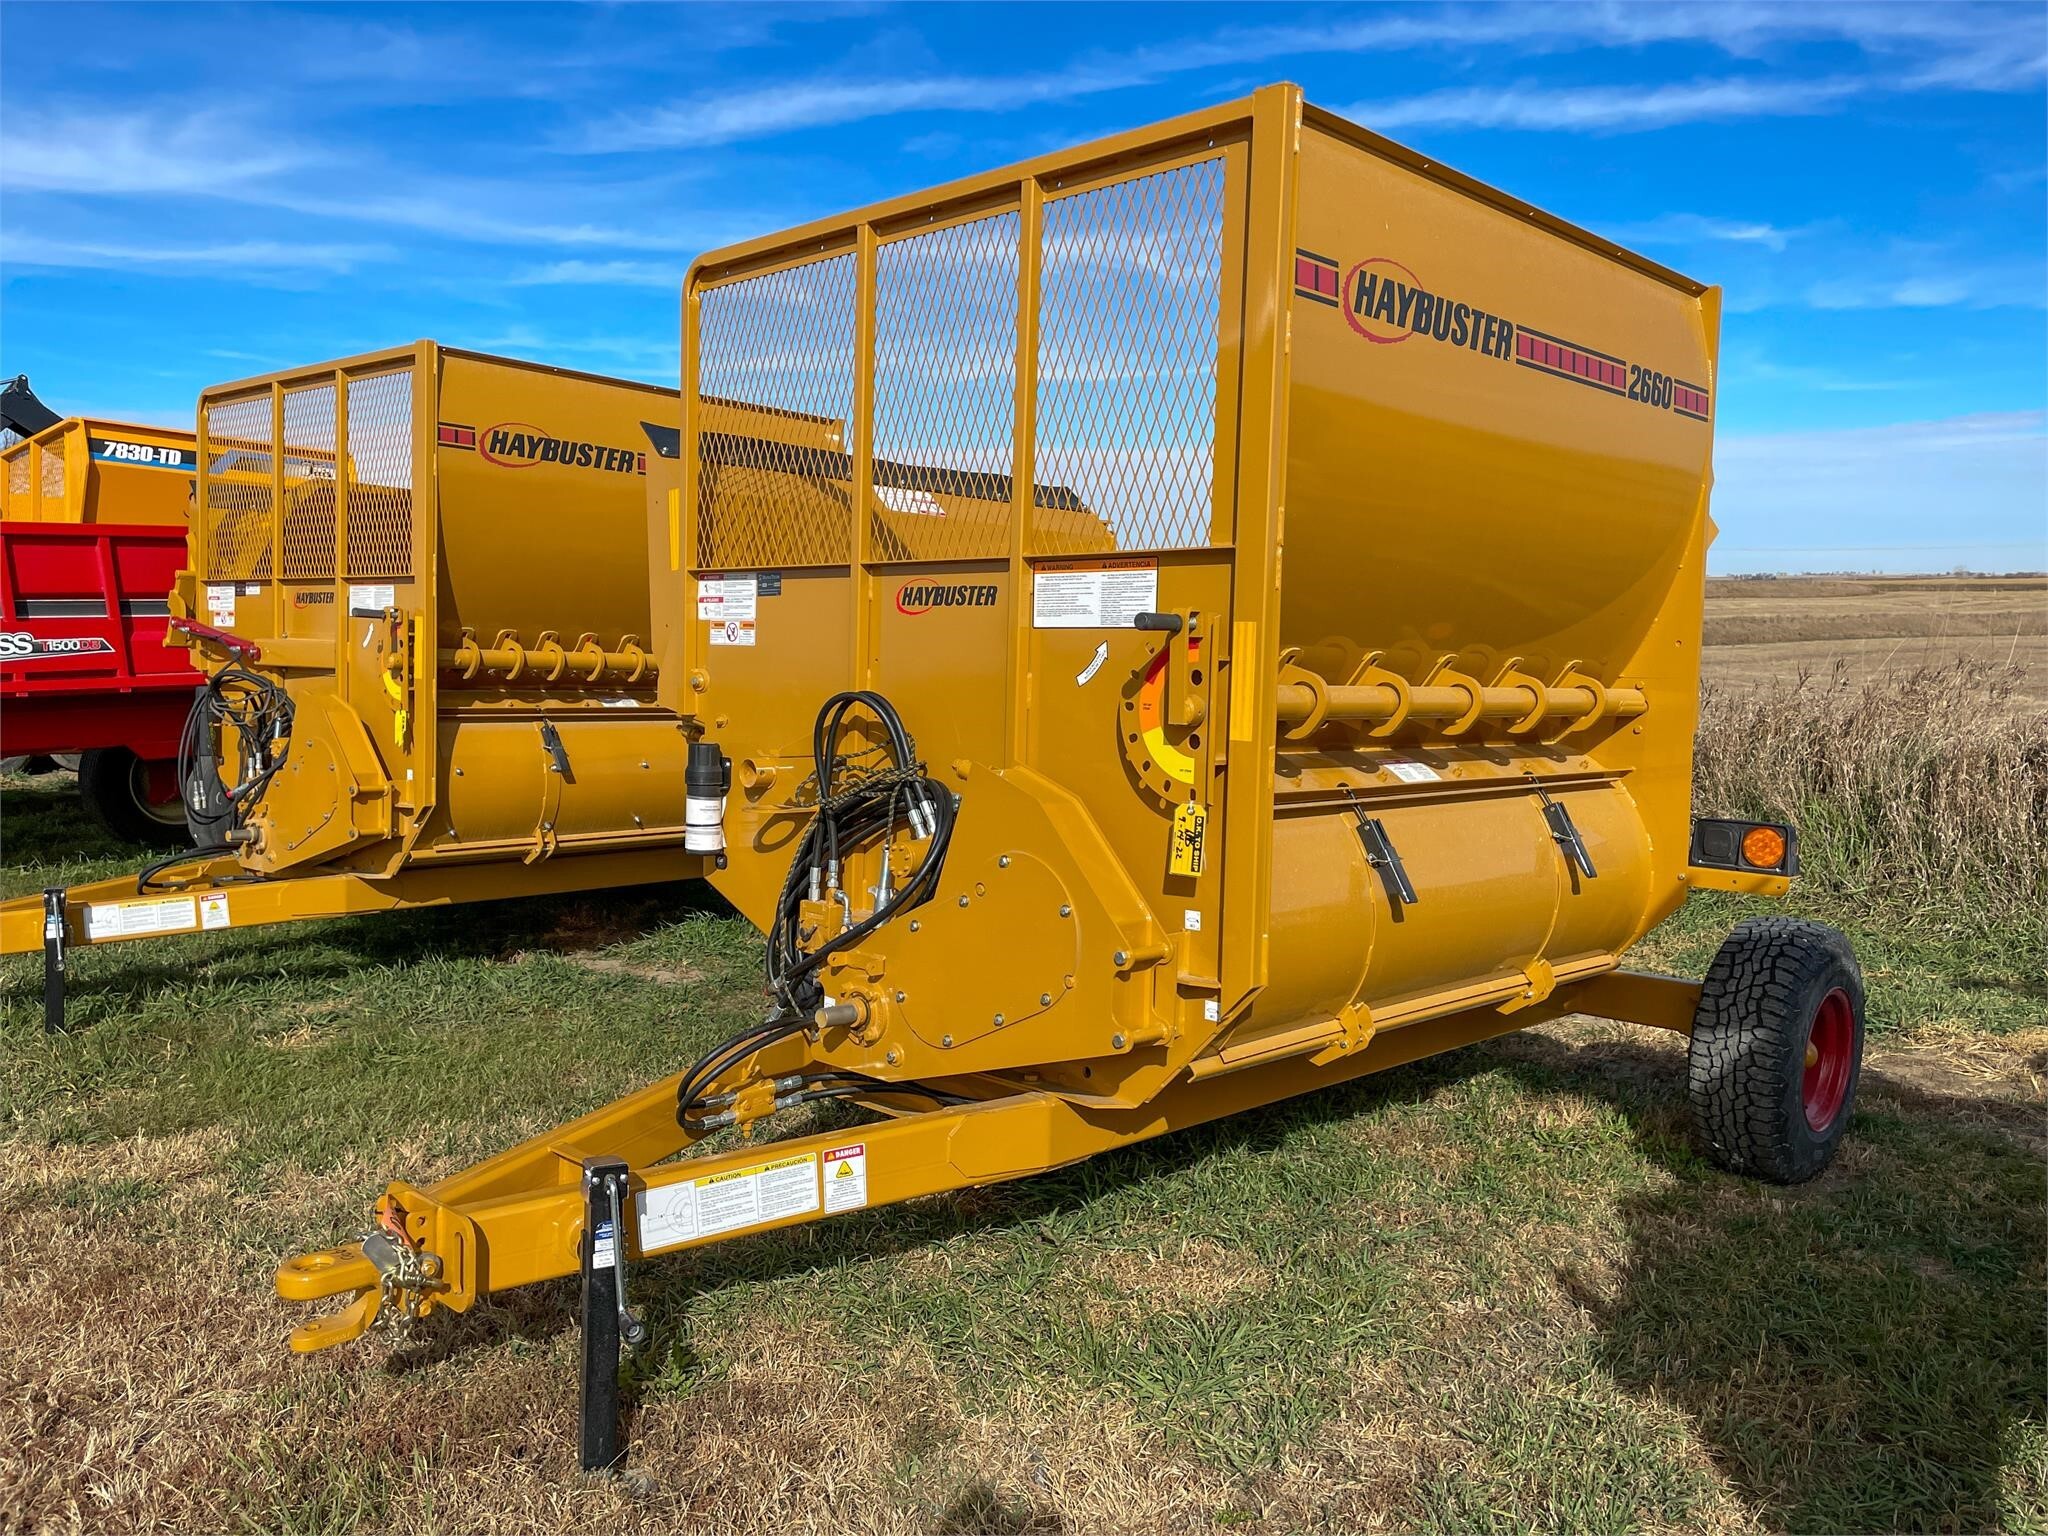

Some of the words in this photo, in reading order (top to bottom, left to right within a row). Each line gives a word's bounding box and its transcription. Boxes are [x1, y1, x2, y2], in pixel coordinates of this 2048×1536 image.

[1354, 269, 1514, 362] HAYBUSTER
[1627, 363, 1674, 410] 2660
[102, 441, 182, 466] 7830-TD
[488, 429, 635, 473] HAYBUSTER
[1108, 560, 1151, 569] ADVERTENCIA
[296, 592, 335, 605] HAYBUSTER
[901, 585, 998, 607] HAYBUSTER
[1192, 850, 1200, 872] SHIP
[835, 1147, 861, 1159] DANGER
[715, 1172, 742, 1183] CAUTION
